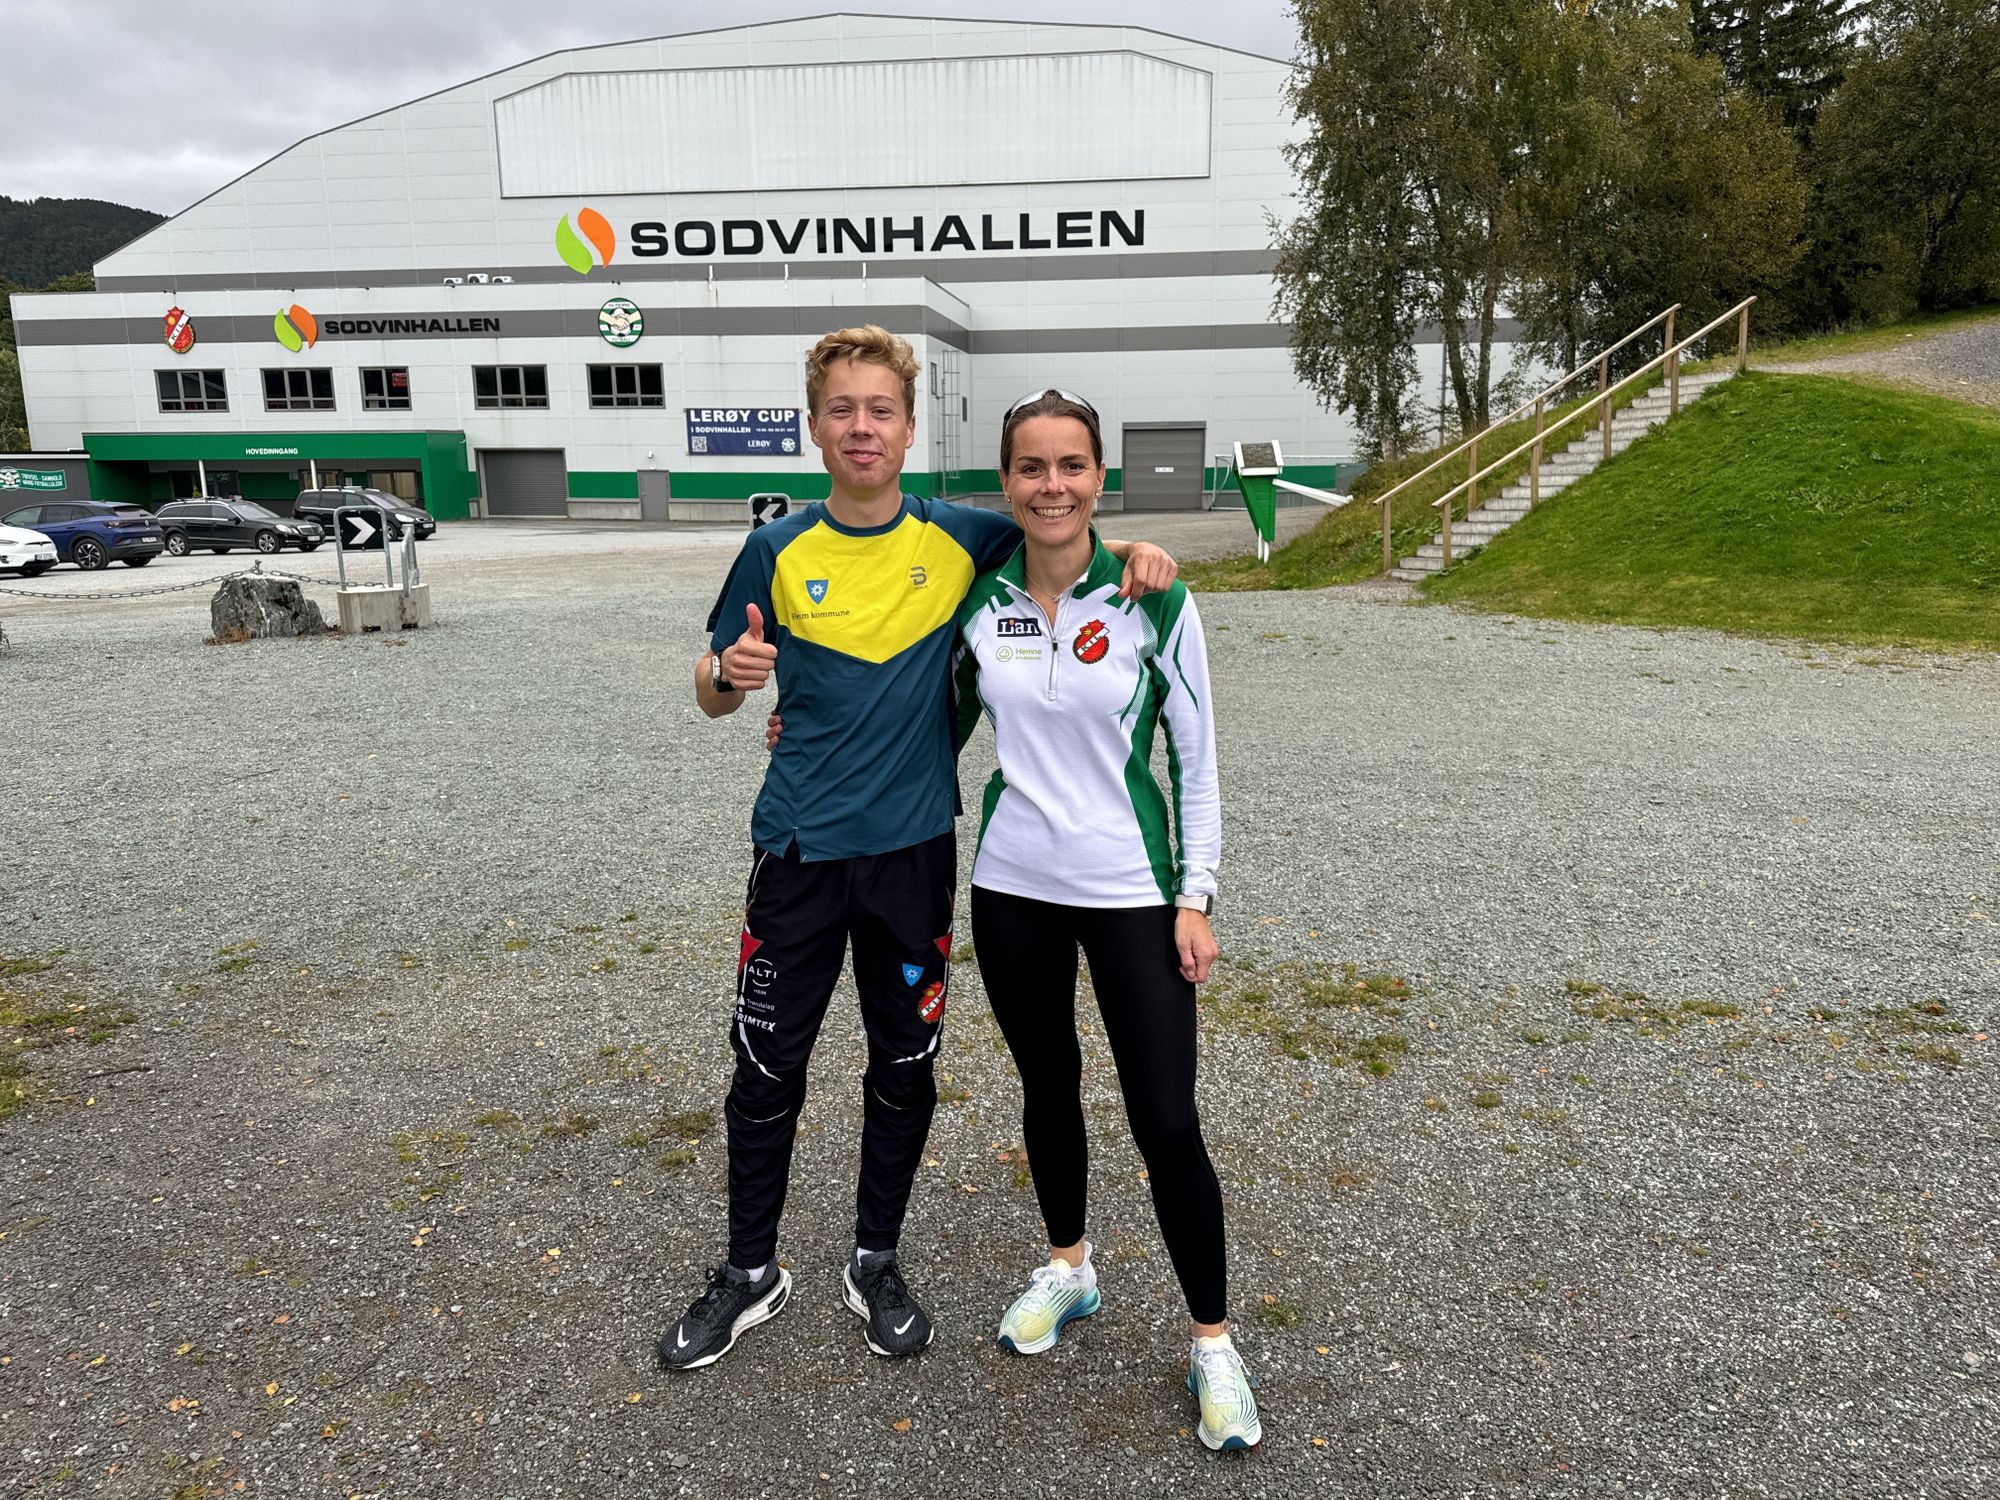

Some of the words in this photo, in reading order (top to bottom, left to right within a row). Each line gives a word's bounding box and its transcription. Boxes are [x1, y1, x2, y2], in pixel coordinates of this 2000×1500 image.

[631, 209, 1145, 257] SODVINHALLEN
[324, 318, 500, 334] SODVINHALLEN
[690, 410, 751, 422] LERØY
[758, 410, 795, 422] CUP
[792, 612, 809, 621] Heim
[810, 610, 850, 619] kommune
[1000, 619, 1039, 635] Lian
[1081, 635, 1102, 652] KIL
[748, 965, 777, 979] ALTI
[733, 1011, 777, 1033] TRIMTEX
